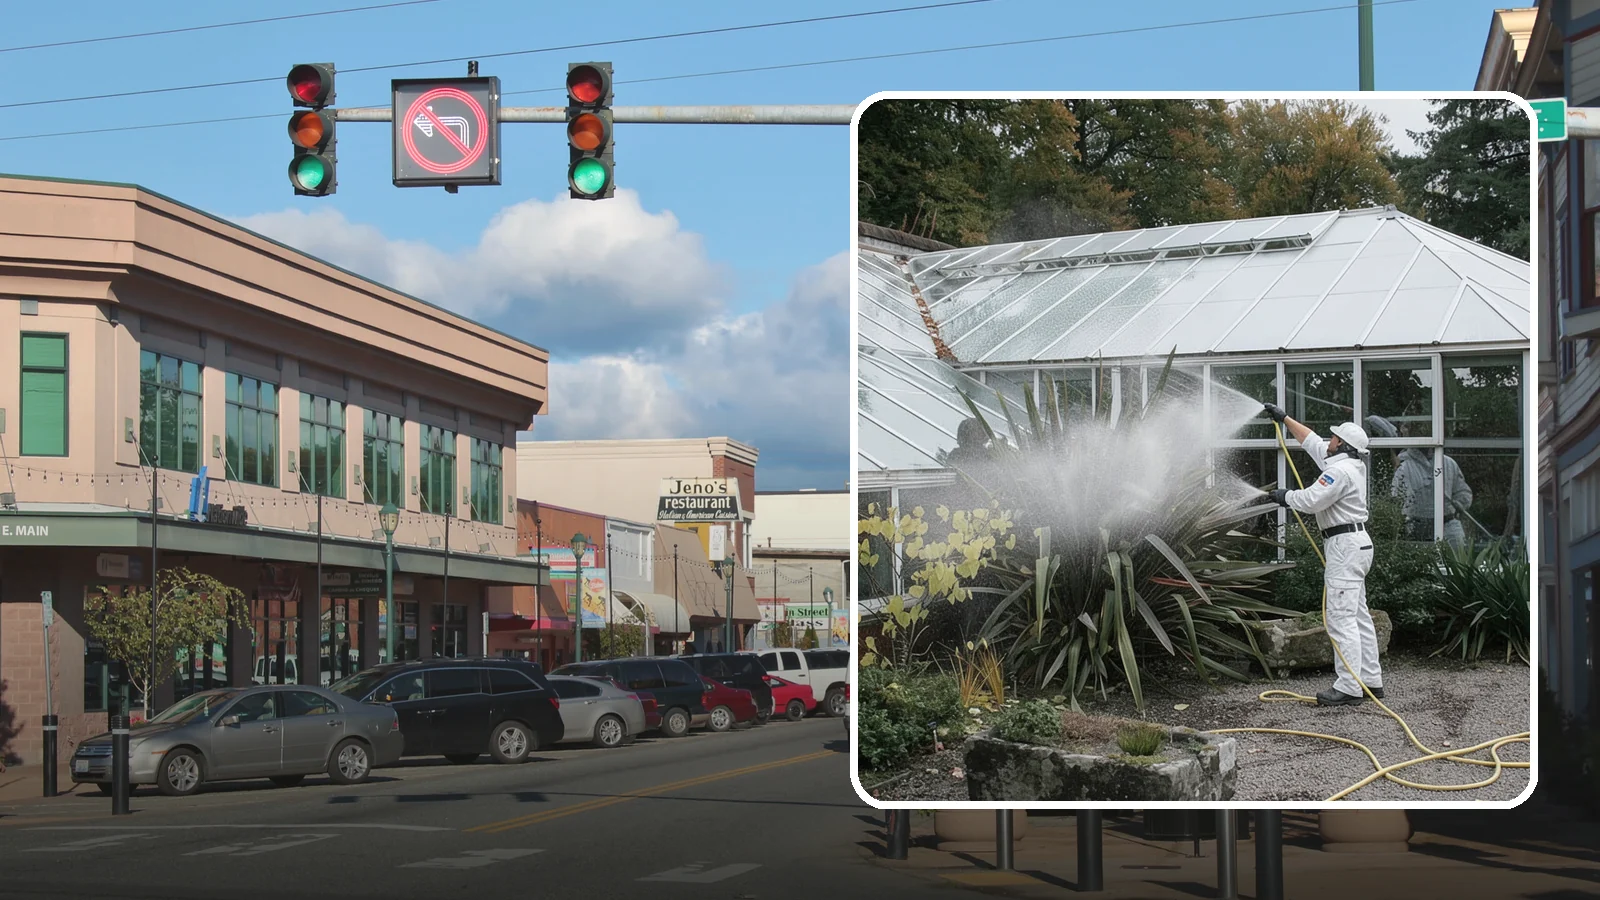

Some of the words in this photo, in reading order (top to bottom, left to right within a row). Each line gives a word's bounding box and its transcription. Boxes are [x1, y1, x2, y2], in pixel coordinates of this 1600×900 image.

[669, 480, 728, 495] Jeno's
[665, 496, 731, 509] restaurant
[658, 509, 681, 520] Italian
[686, 509, 715, 519] American
[715, 509, 738, 519] Cuisine
[2, 525, 13, 536] E.
[15, 525, 49, 536] MAIN
[797, 607, 828, 617] Street
